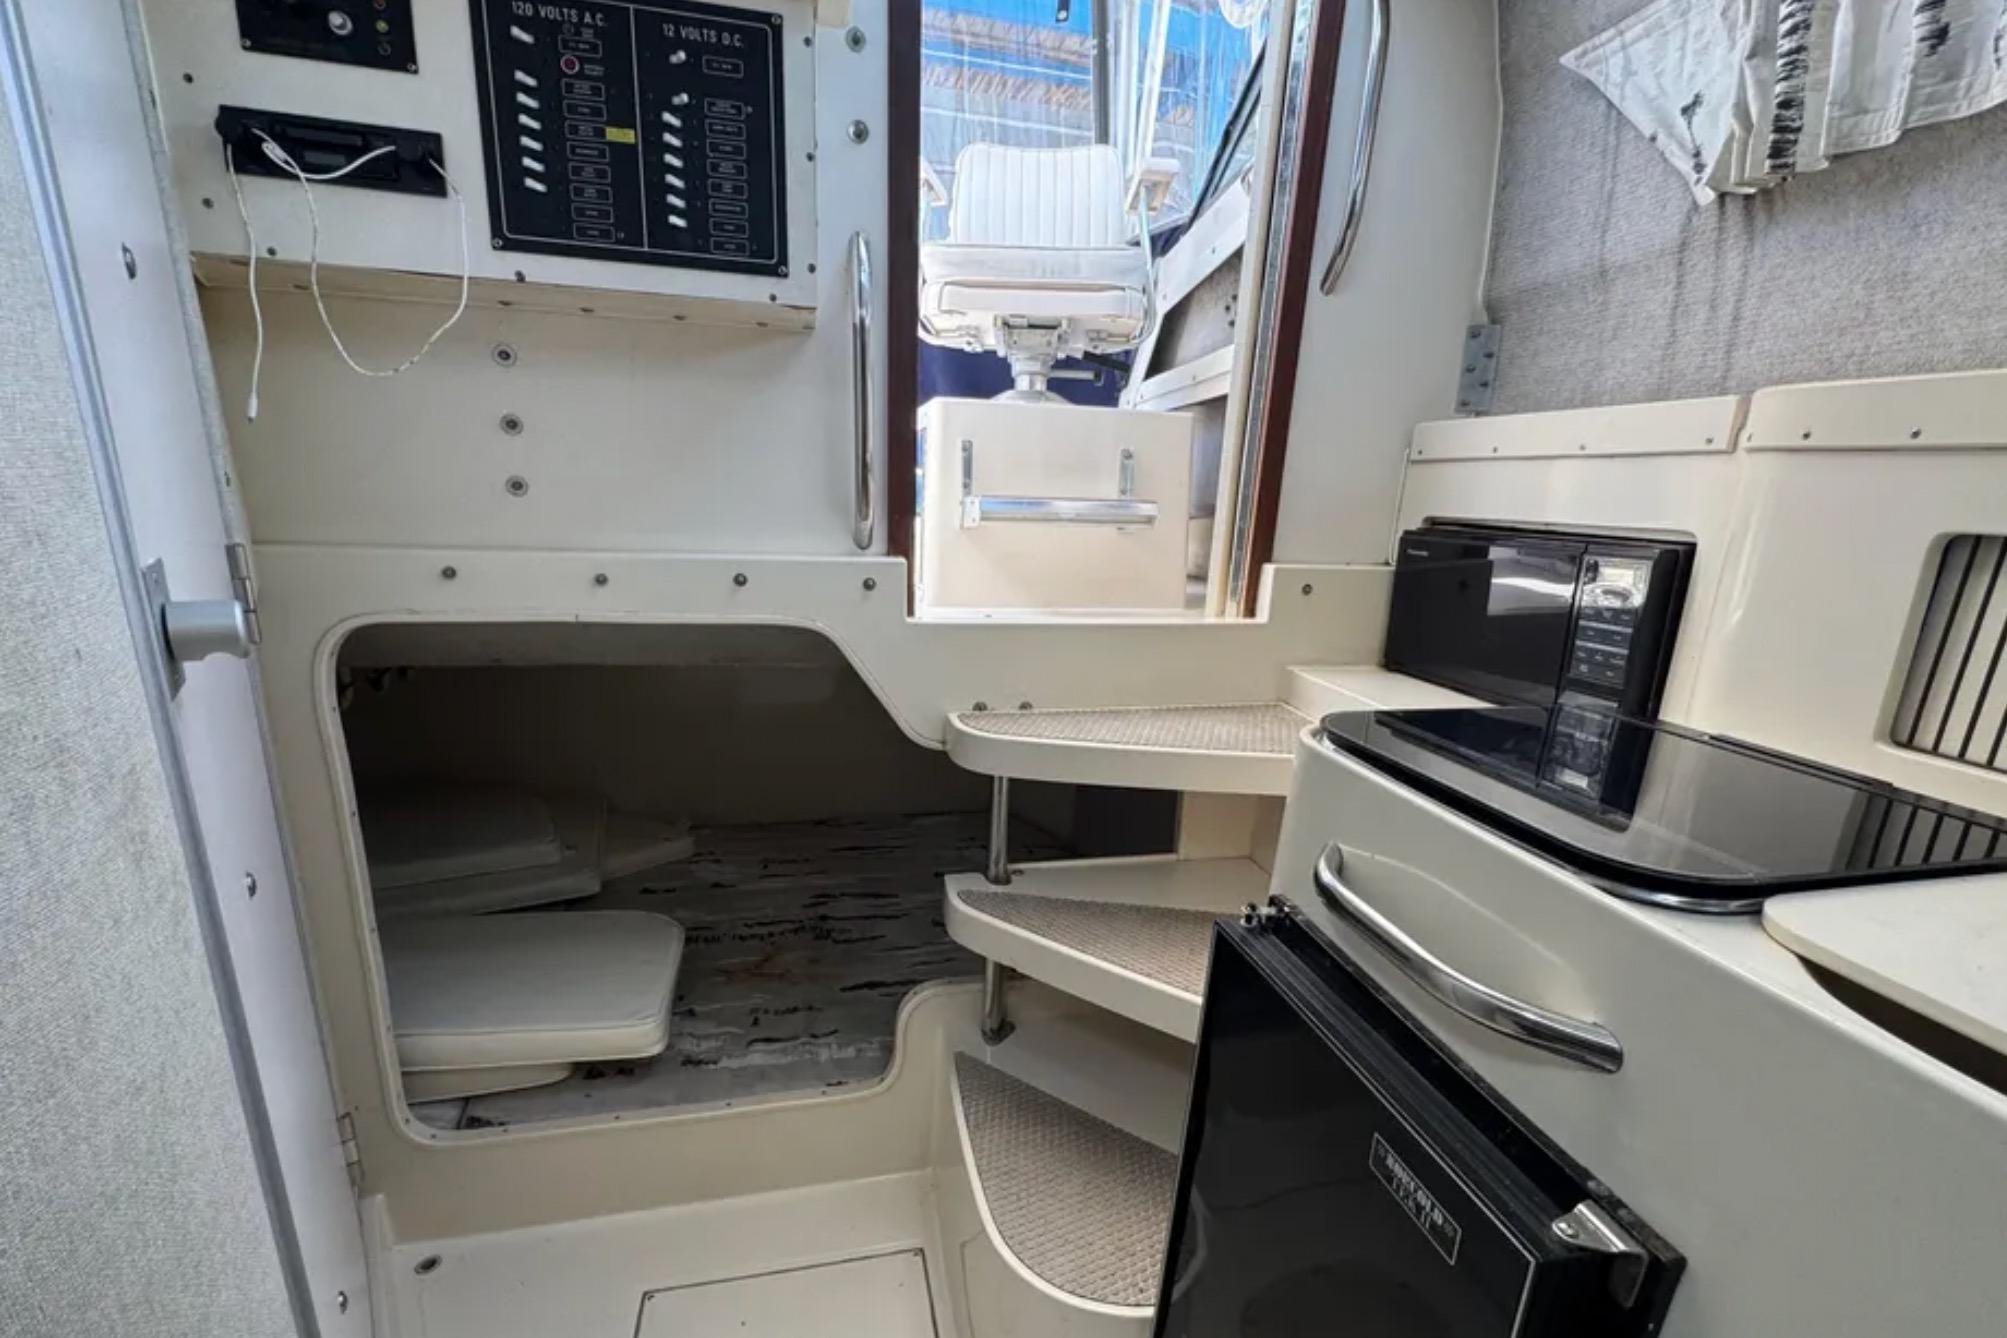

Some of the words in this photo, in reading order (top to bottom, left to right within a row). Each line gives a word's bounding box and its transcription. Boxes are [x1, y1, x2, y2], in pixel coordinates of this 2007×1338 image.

[512, 0, 533, 17] 120
[538, 4, 579, 23] VOLTS
[662, 23, 675, 38] 12
[680, 24, 718, 43] VOLTS
